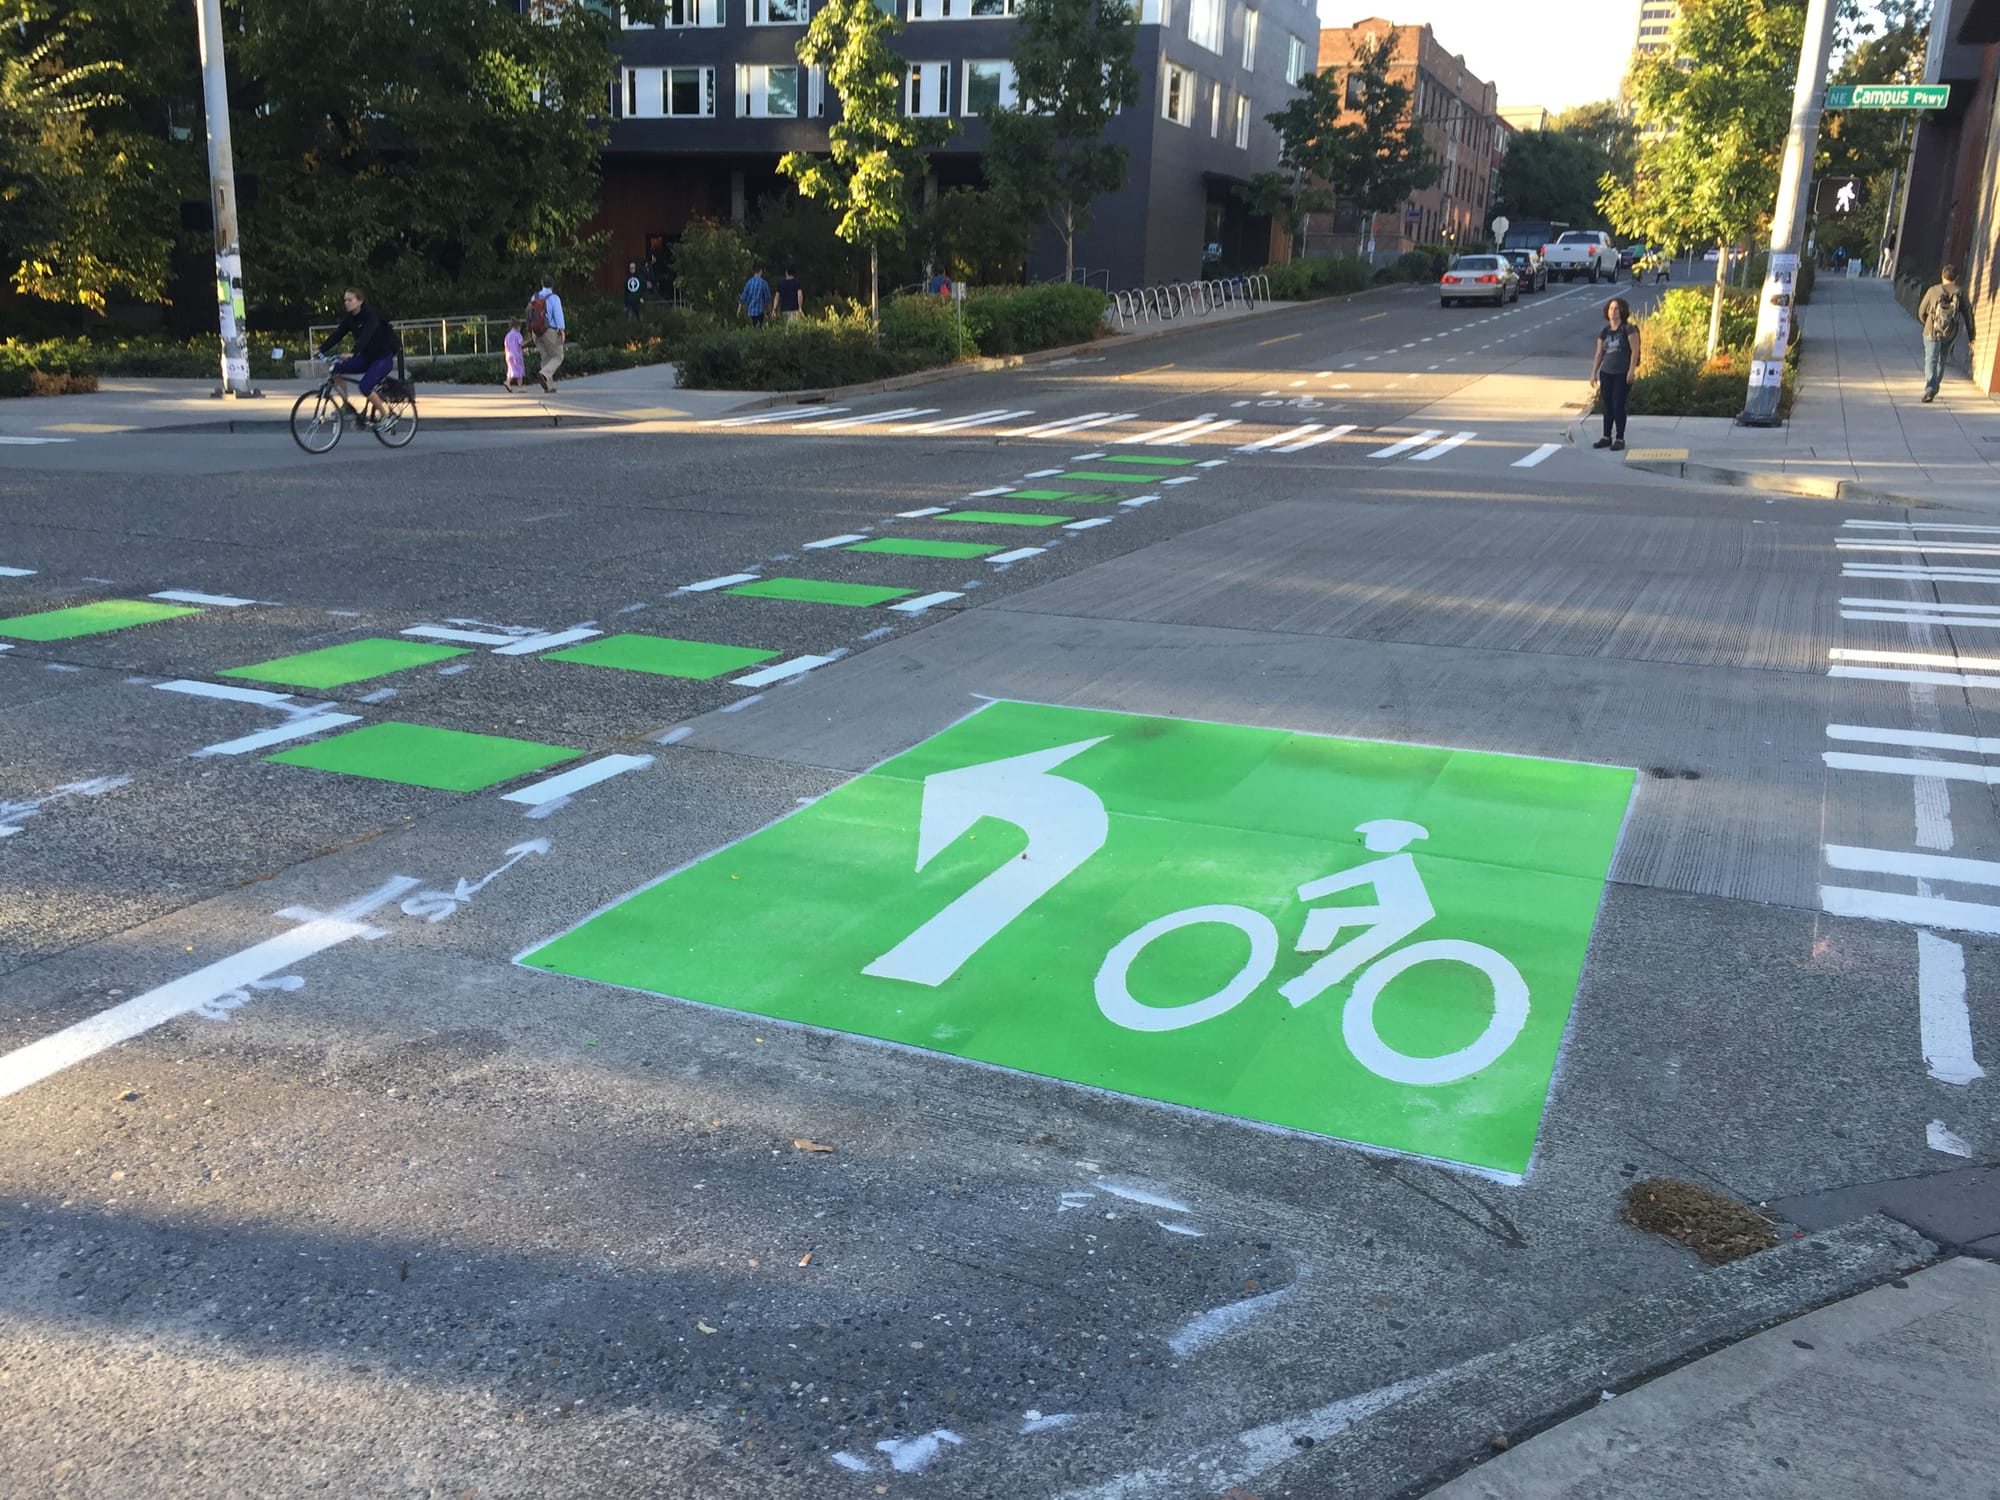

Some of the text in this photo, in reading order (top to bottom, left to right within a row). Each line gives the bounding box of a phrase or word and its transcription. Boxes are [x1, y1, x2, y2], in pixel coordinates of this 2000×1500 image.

[1830, 87, 1945, 106] NE Campus Pkwy
